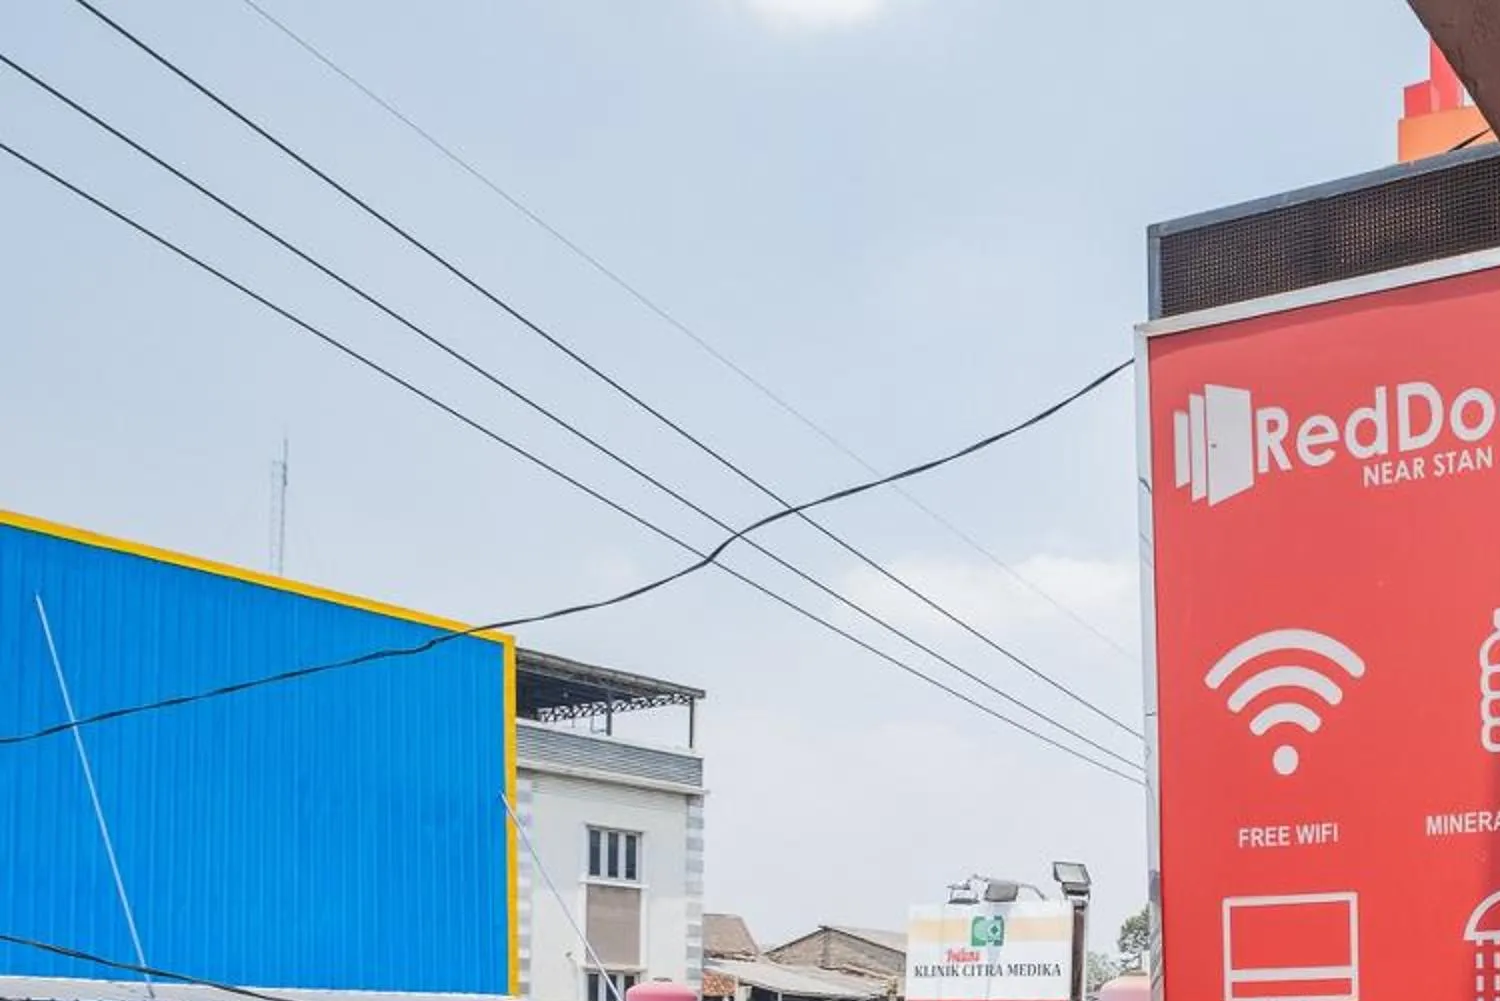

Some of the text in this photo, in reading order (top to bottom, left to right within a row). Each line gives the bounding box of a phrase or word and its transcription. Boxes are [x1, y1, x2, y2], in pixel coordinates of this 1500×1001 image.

[1362, 459, 1425, 488] NEAR
[1433, 445, 1493, 477] STAN
[1238, 821, 1339, 849] FREE WIFI
[914, 963, 1061, 978] KLINIK CITRA MEDIKA
